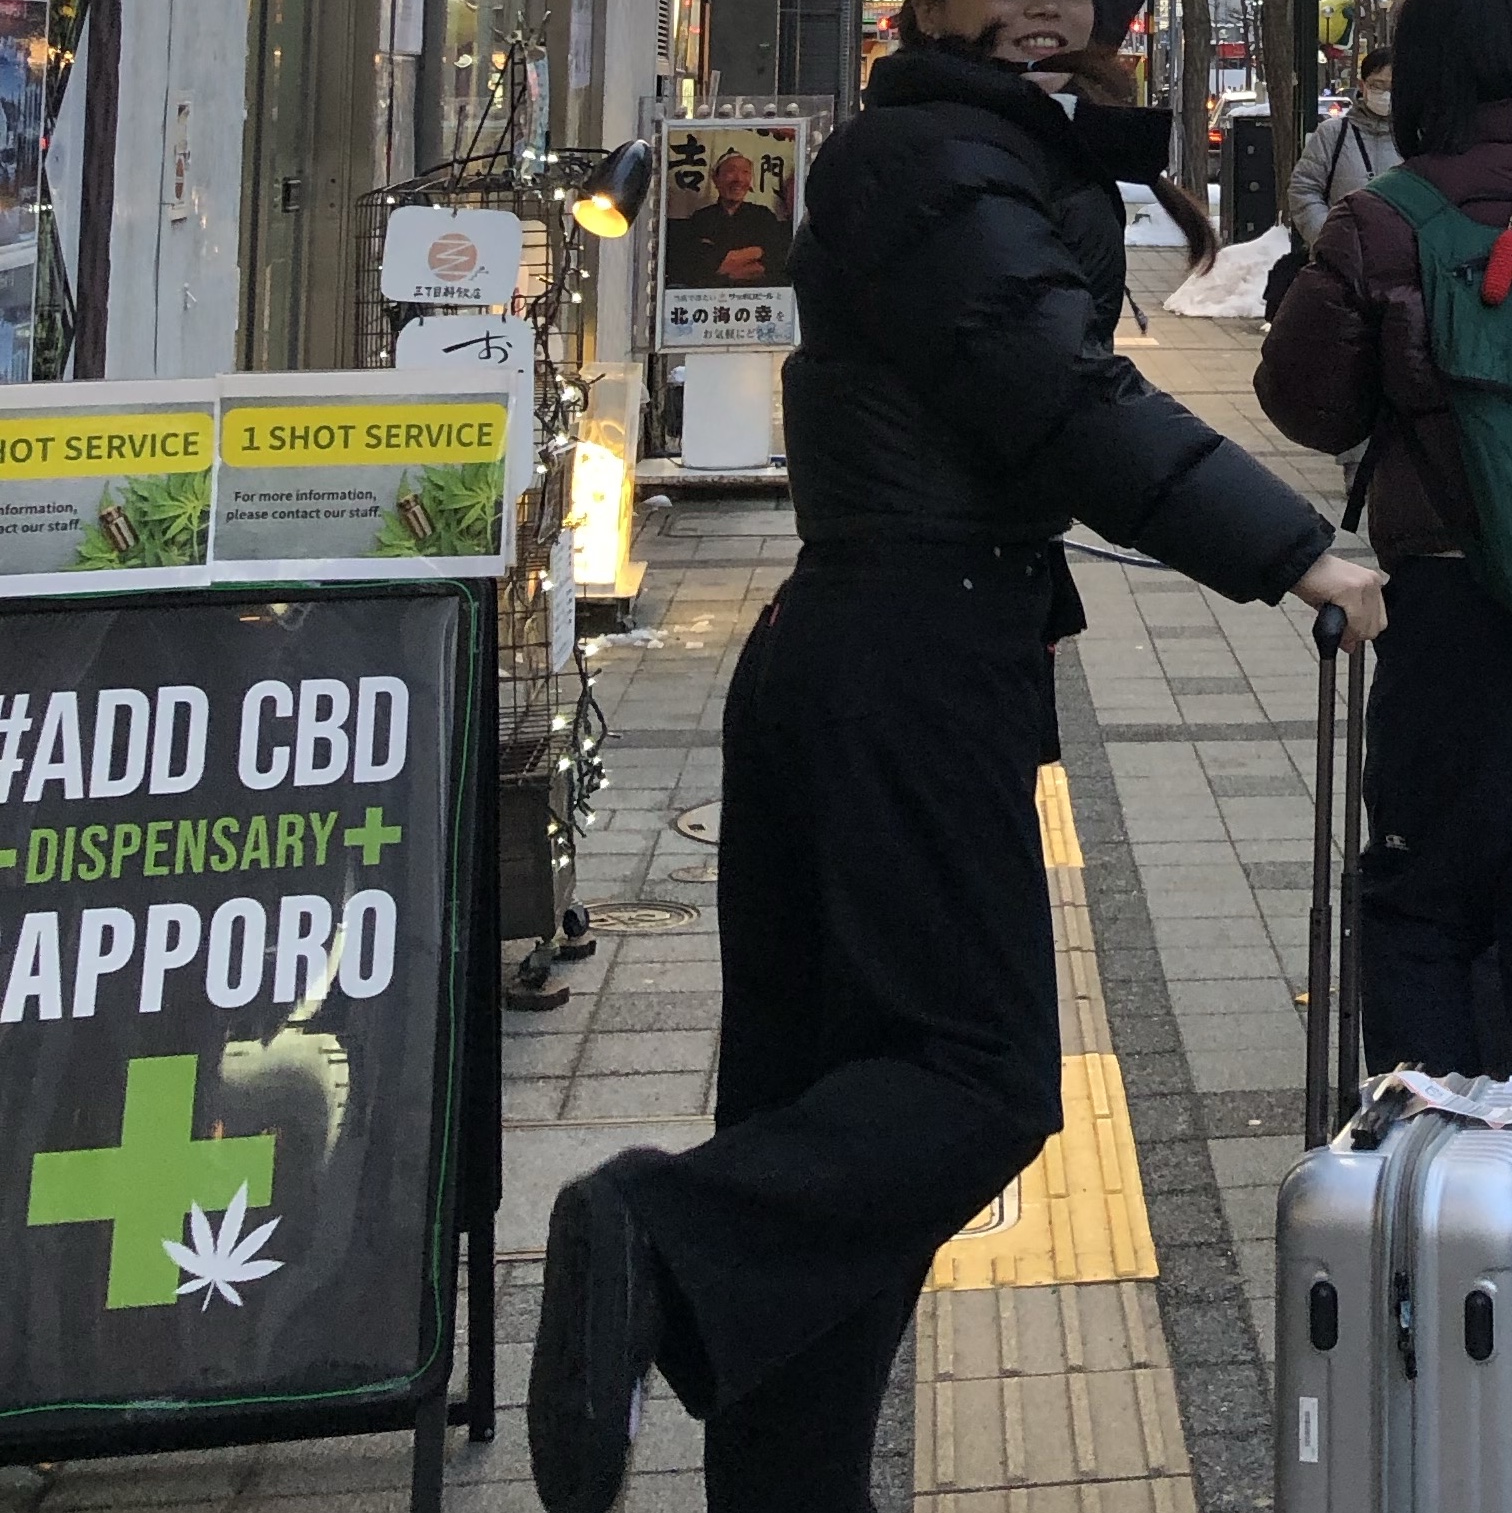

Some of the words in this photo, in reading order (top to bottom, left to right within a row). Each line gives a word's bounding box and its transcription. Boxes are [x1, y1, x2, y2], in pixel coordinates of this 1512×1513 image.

[668, 134, 785, 199] 吉門
[64, 431, 200, 462] SERVICE
[241, 426, 261, 452] 1
[268, 424, 356, 451] SHOT
[365, 422, 494, 450] SERVICE
[234, 491, 256, 503] For
[259, 491, 293, 503] more
[296, 488, 377, 502] information,
[22, 523, 45, 534] our
[226, 509, 269, 522] please
[272, 508, 321, 520] contact
[324, 509, 347, 519] our
[349, 505, 382, 519] staff.
[238, 675, 410, 791] CBD
[25, 811, 340, 885] DISPENSARY
